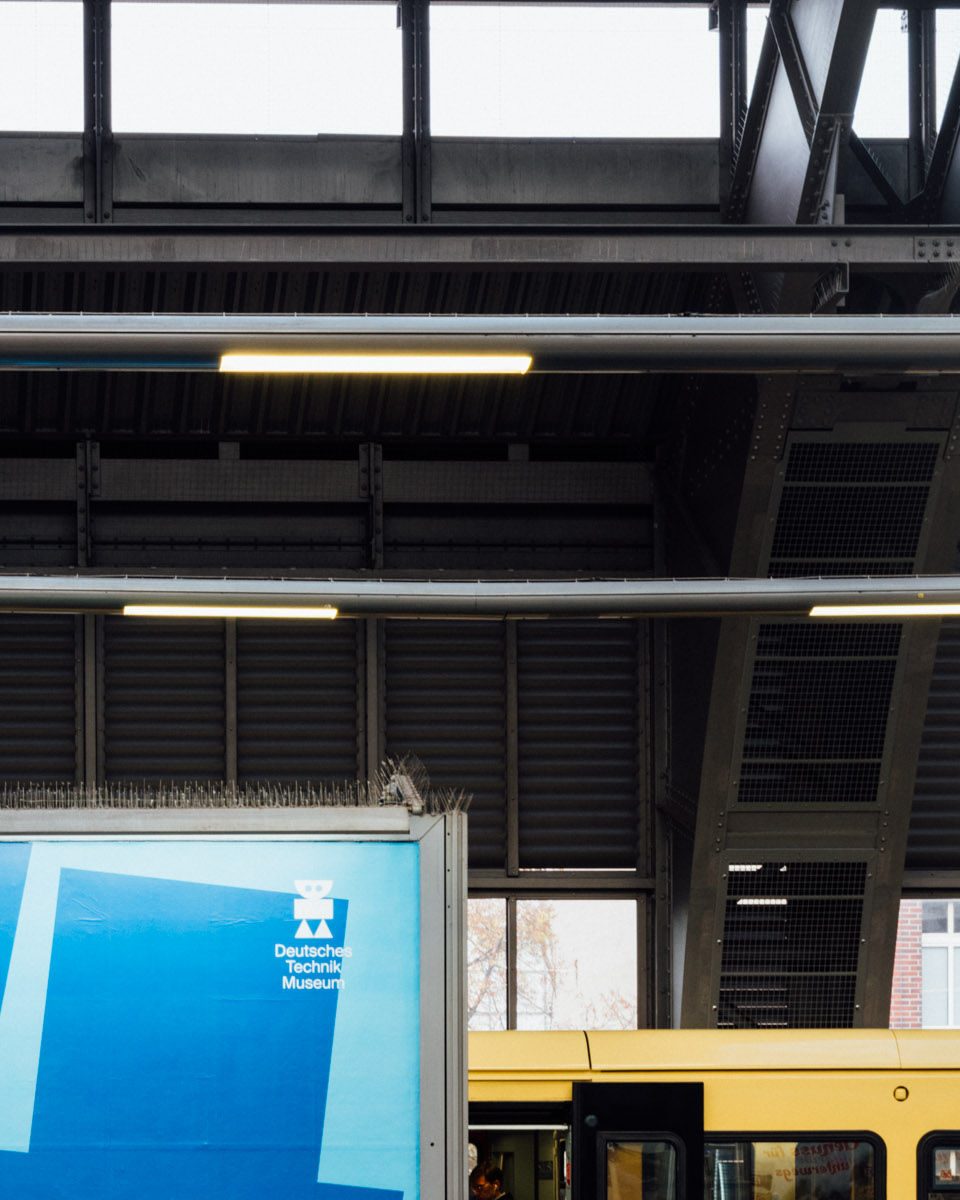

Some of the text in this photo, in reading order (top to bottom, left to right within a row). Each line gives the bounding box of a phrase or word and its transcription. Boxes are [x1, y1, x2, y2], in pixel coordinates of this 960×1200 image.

[274, 943, 353, 958] Deutsches
[285, 959, 342, 974] Technik
[282, 975, 346, 990] Museum
